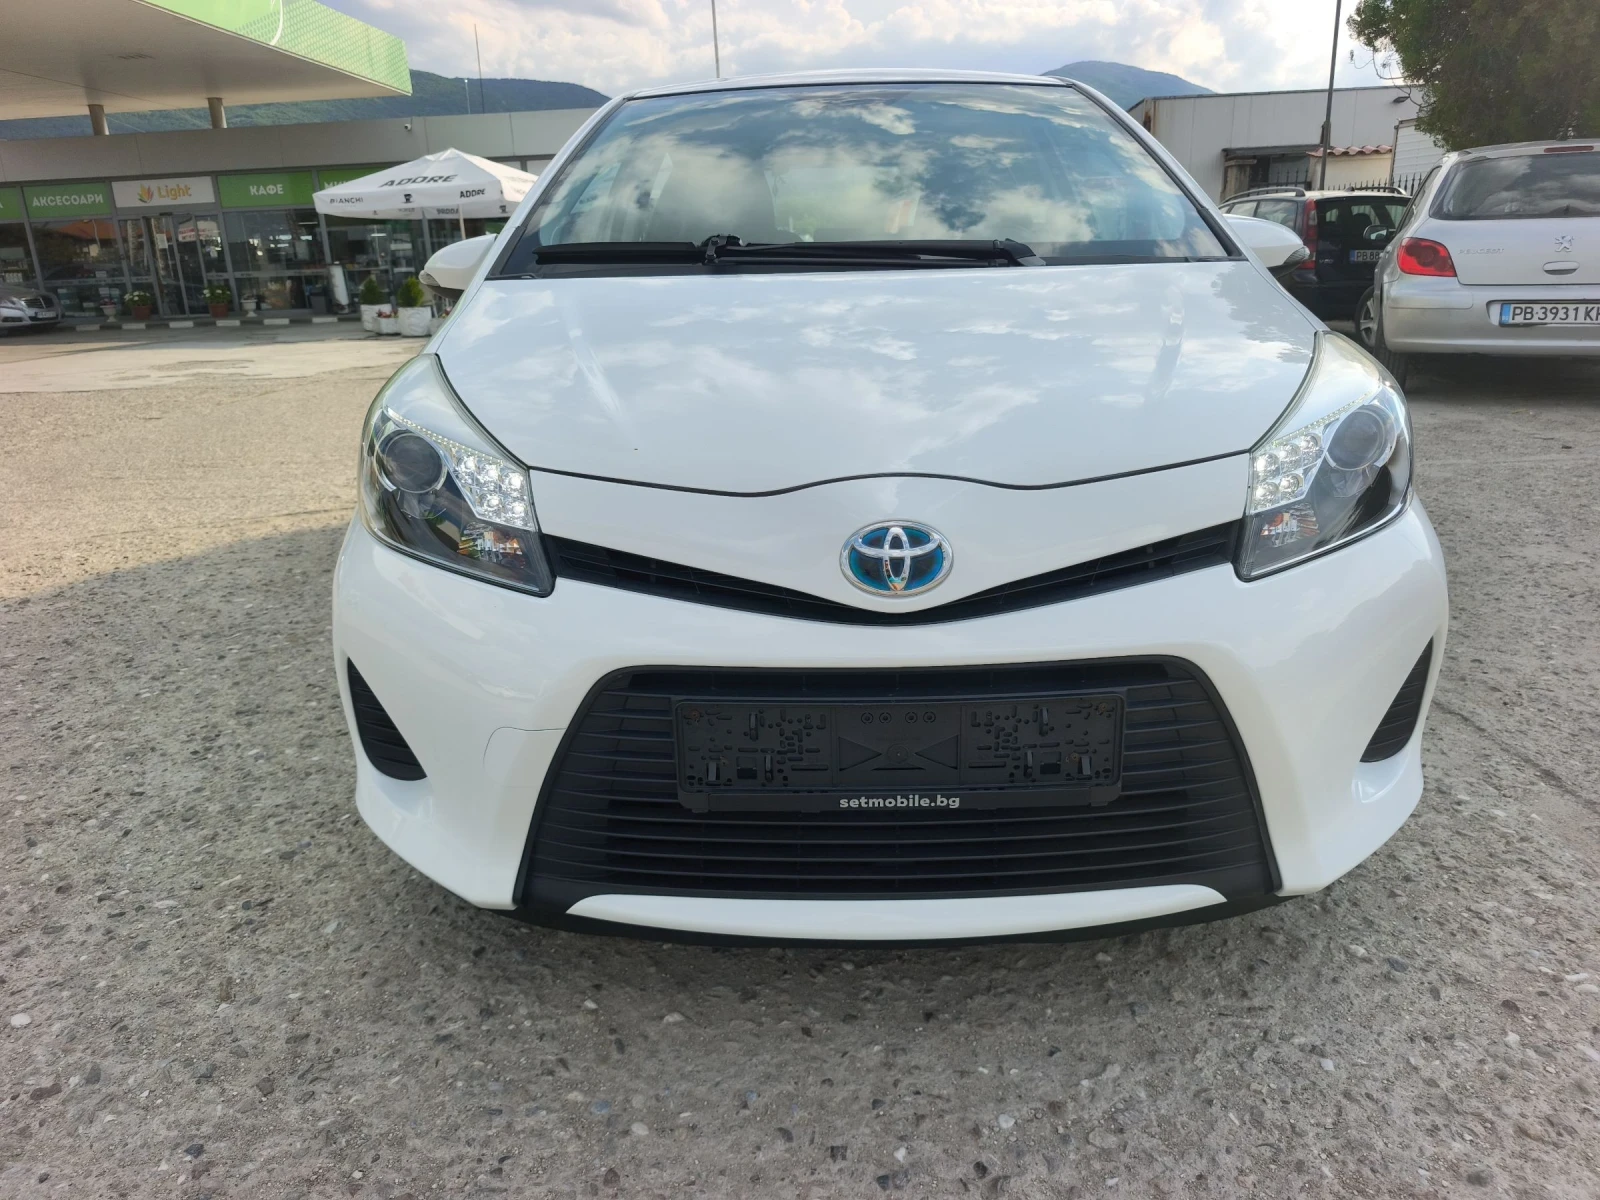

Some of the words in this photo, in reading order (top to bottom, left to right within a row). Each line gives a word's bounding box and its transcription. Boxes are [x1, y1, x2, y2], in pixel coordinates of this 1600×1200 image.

[157, 183, 192, 200] Light
[249, 184, 284, 196] КАФЕ
[32, 194, 104, 207] АКСЕСОАРИ
[1537, 306, 1580, 321] 3931
[839, 794, 960, 809] setmobile.bg
